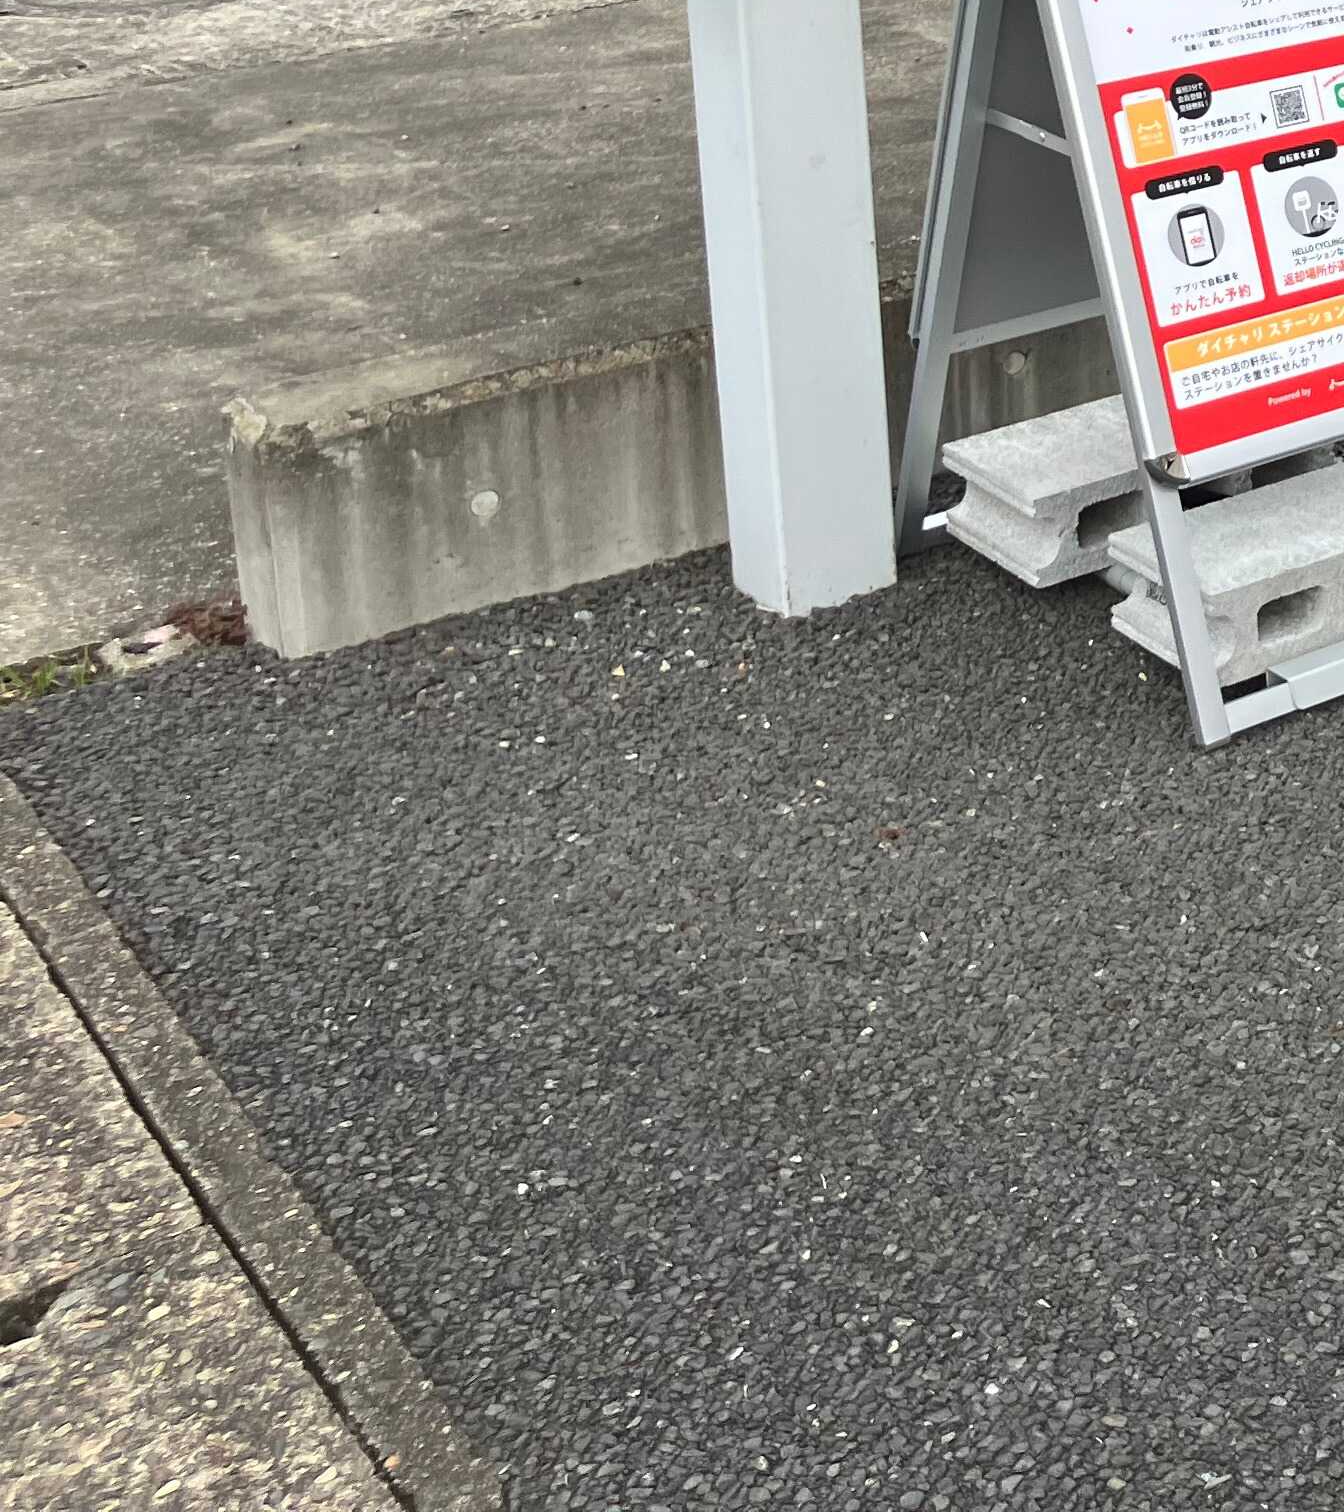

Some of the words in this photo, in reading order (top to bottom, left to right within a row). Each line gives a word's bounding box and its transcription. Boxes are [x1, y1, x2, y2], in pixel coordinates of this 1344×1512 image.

[1179, 111, 1251, 135] QRコードを読み取って
[1278, 146, 1321, 165] 自転車を返す
[1157, 171, 1212, 194] 自転車を借りる
[1291, 244, 1313, 256] HELLO
[1174, 270, 1239, 296] アプリで自転車を
[1169, 282, 1252, 318] かんたん予約
[1195, 325, 1264, 359] ダイチャリ
[1183, 352, 1318, 402] ステーションを置きませんか？
[1267, 388, 1300, 406] Powered
[1300, 385, 1312, 398] by
